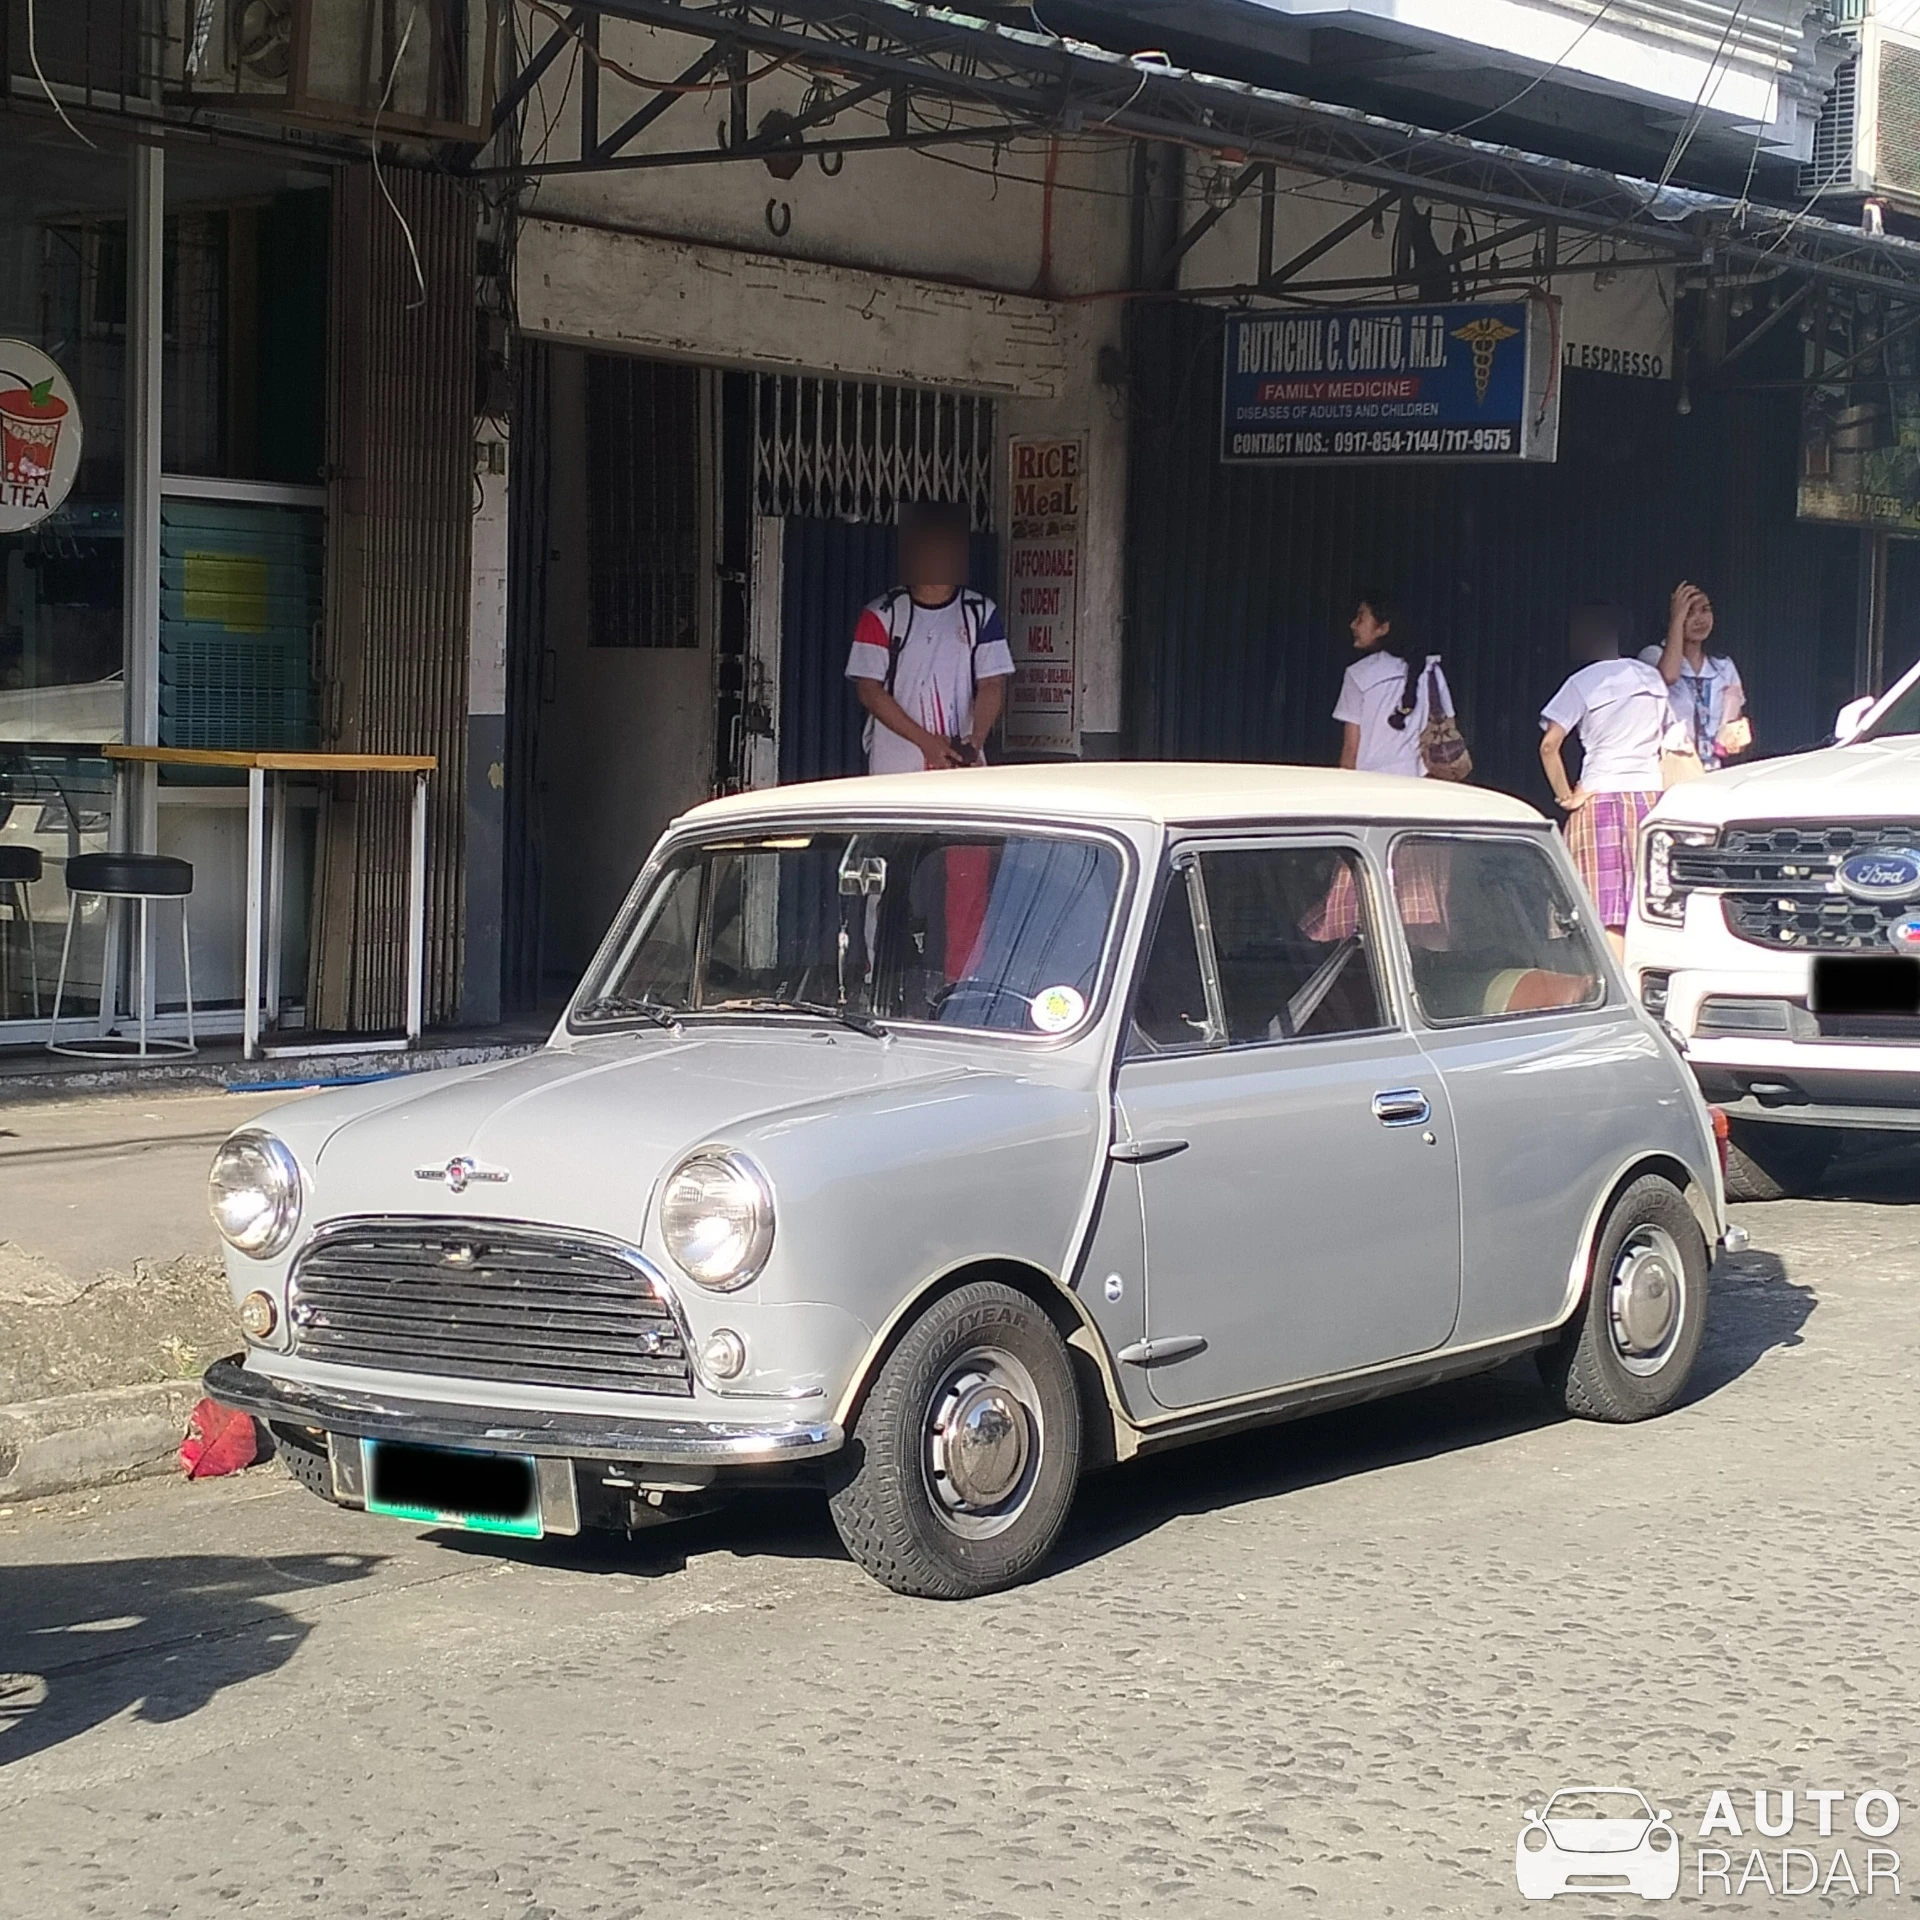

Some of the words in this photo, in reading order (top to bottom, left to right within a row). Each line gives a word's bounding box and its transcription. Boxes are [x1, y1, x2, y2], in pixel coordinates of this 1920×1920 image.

[1238, 319, 1323, 374] RUTHCHIL
[1326, 318, 1343, 372] C.
[1347, 316, 1406, 375] CHITO,
[1409, 315, 1447, 369] M.D.
[1581, 344, 1663, 378] ESPRESSO
[1264, 383, 1325, 400] FAMILY
[1327, 381, 1411, 399] MEDICINE
[1236, 406, 1291, 420] DISEASES
[1292, 405, 1309, 419] OF
[1309, 404, 1353, 419] ADULTS
[1354, 404, 1380, 418] AND
[1381, 402, 1439, 418] CHILDREN
[1233, 432, 1294, 454] CONTACT
[1294, 432, 1330, 454] NOS.:
[1013, 549, 1073, 577] AFFORDABLE
[1020, 587, 1060, 616] STUDENT
[1027, 625, 1054, 654] MEAL
[1857, 862, 1906, 884] Ford
[910, 1307, 1029, 1401] GOODYEAR
